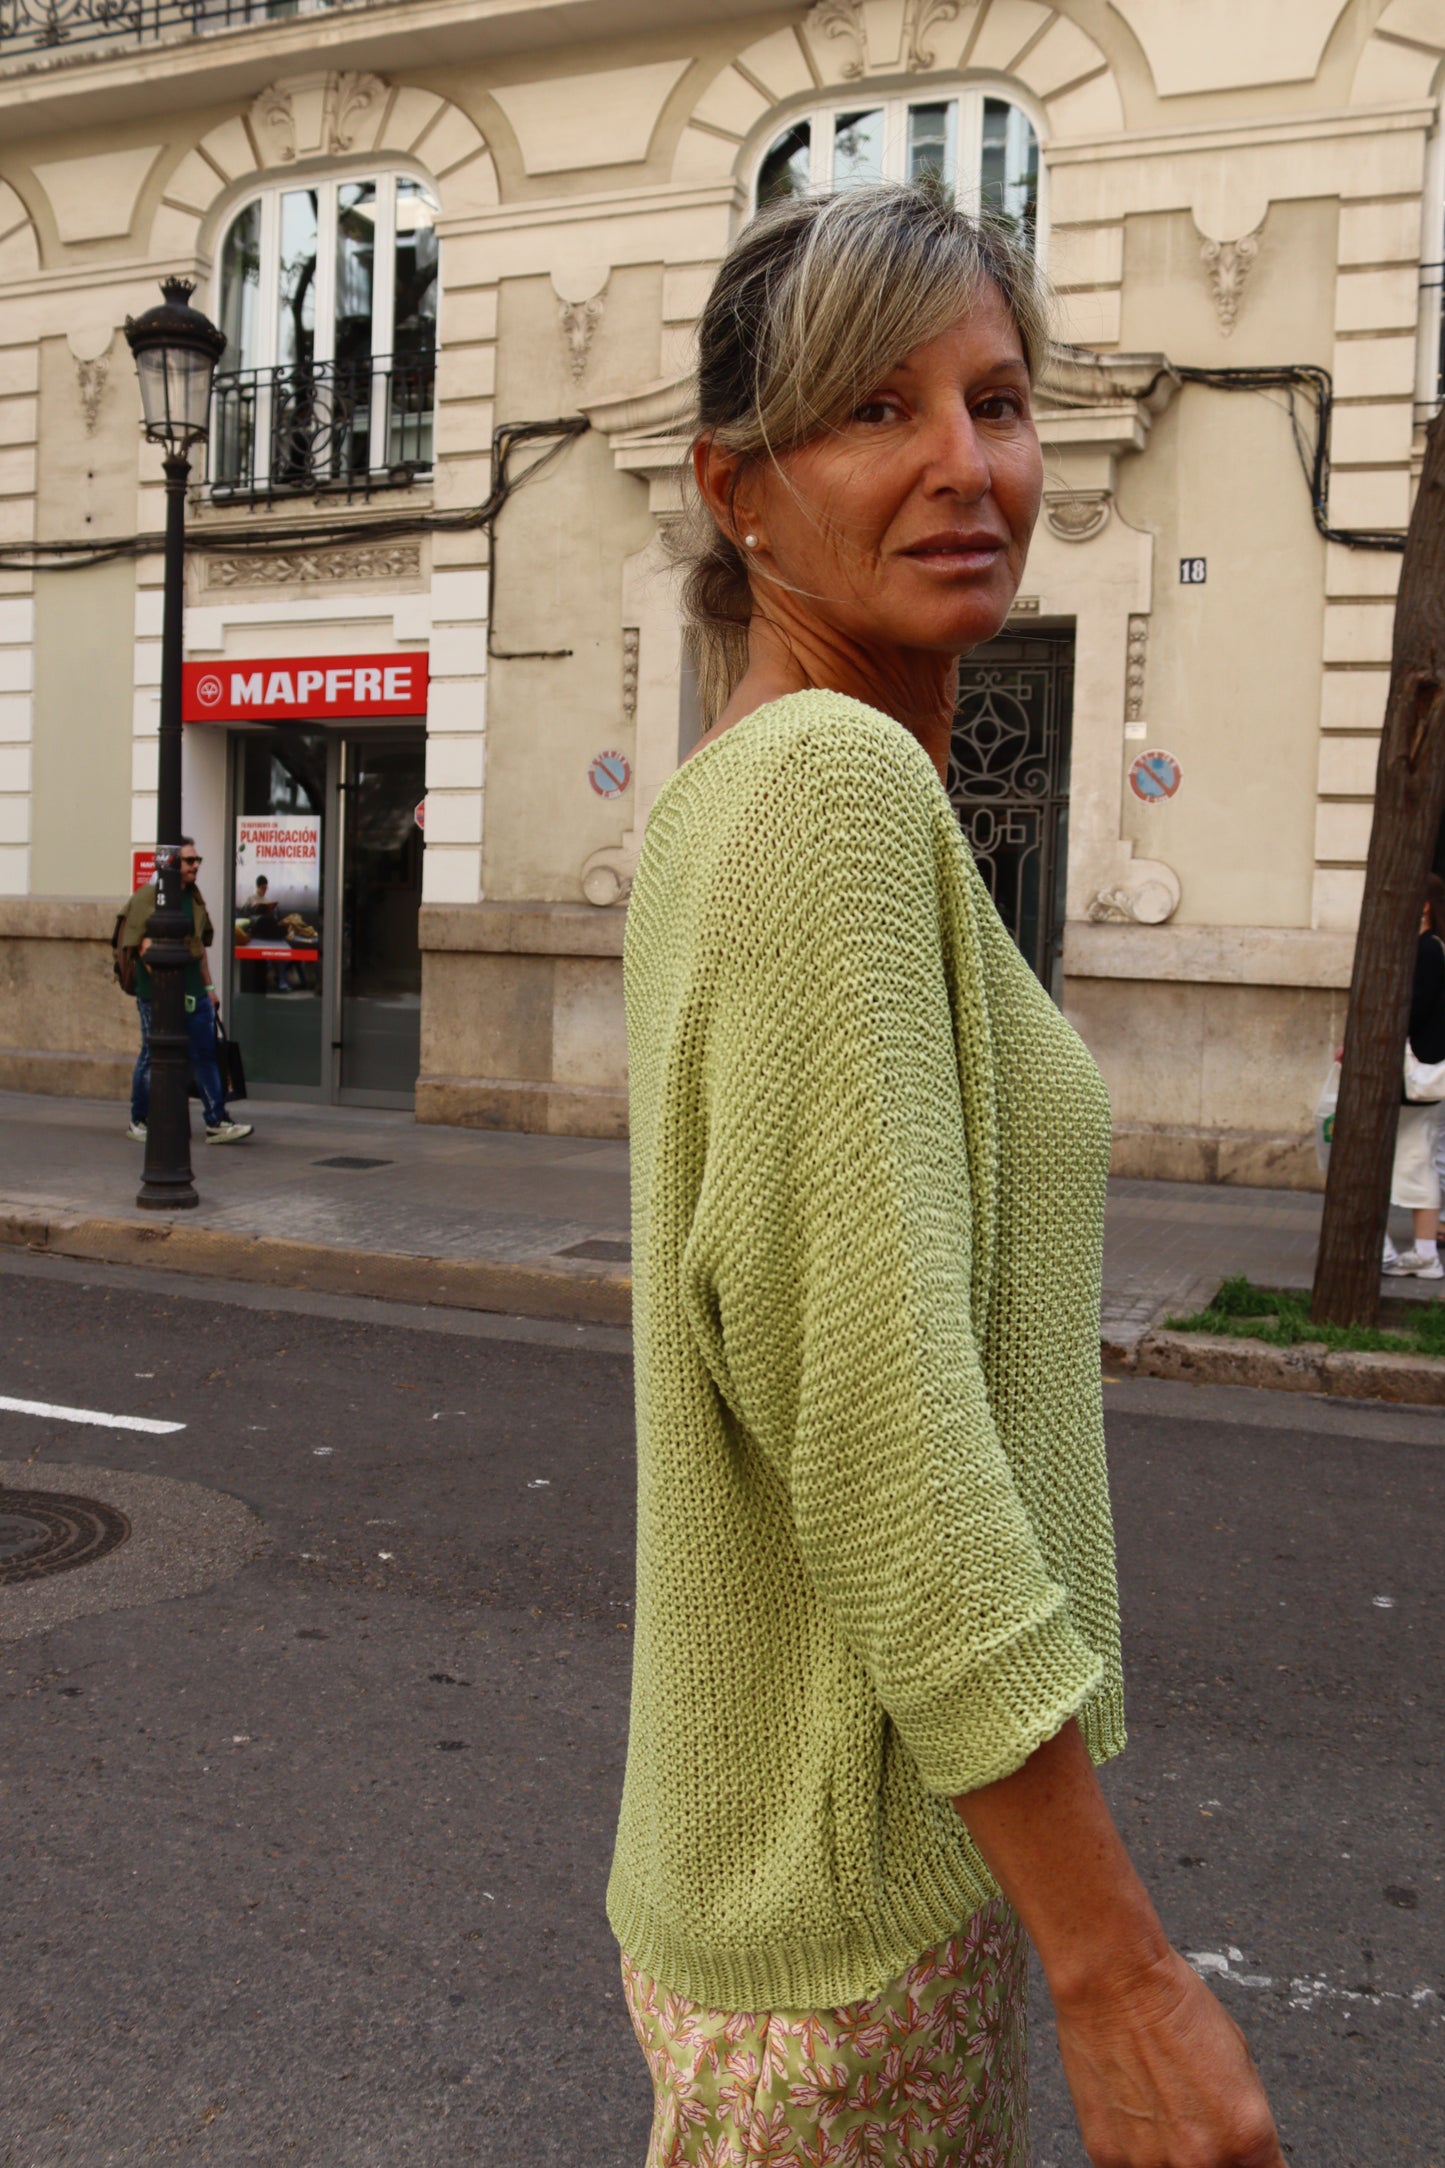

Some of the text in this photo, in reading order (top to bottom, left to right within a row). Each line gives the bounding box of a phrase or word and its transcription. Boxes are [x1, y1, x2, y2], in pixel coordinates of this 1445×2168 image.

[1181, 559, 1205, 582] 18
[230, 666, 412, 706] MAPFRE
[240, 826, 317, 843] PLANIFICACIÓN
[255, 844, 316, 858] FINANCIERA
